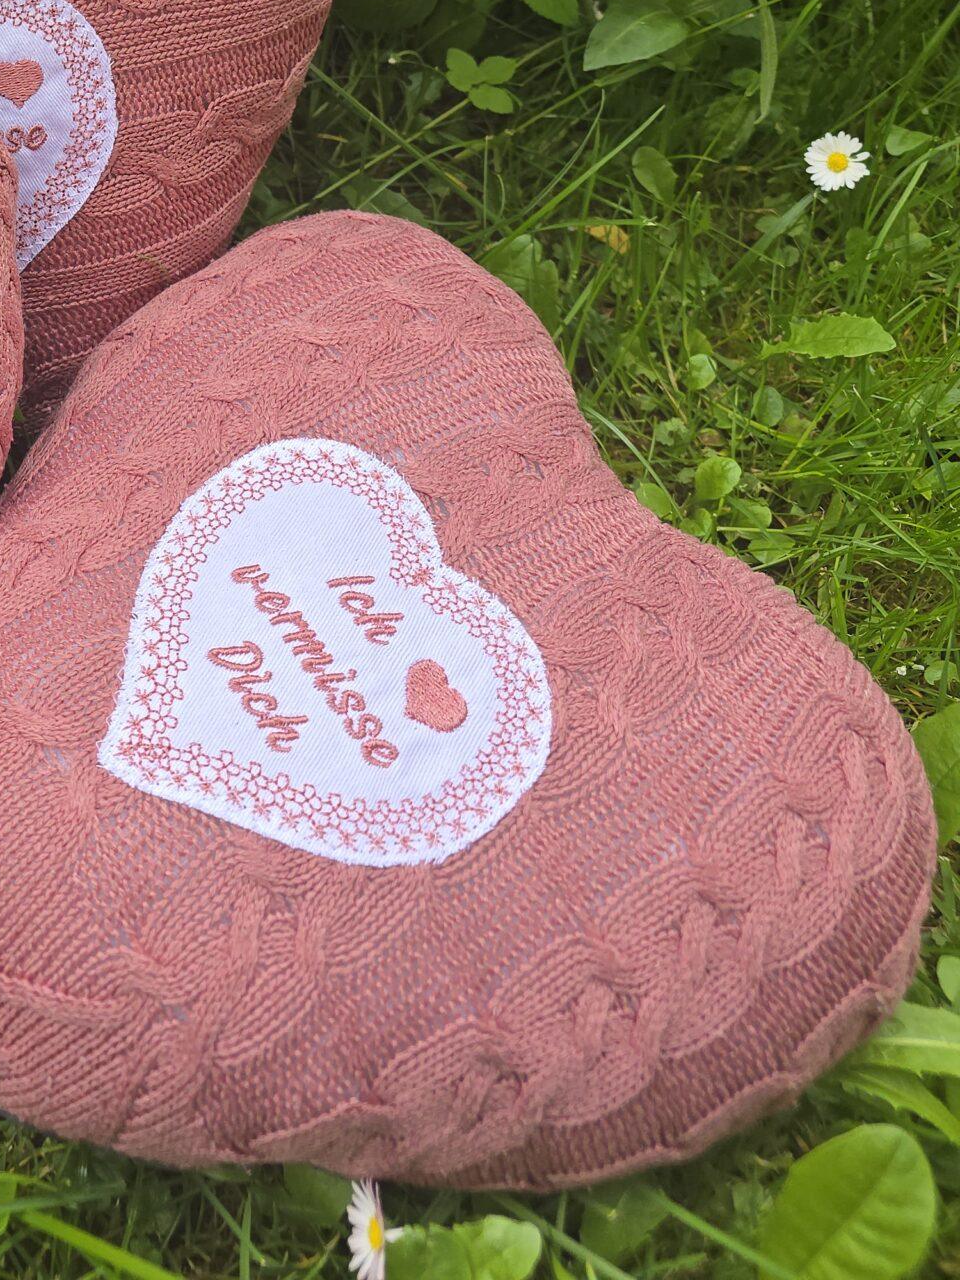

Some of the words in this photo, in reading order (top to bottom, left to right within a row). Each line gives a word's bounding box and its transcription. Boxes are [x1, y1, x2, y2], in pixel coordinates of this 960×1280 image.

[231, 564, 400, 769] vermisse
[326, 575, 404, 646] Ich
[206, 641, 308, 753] Dich
